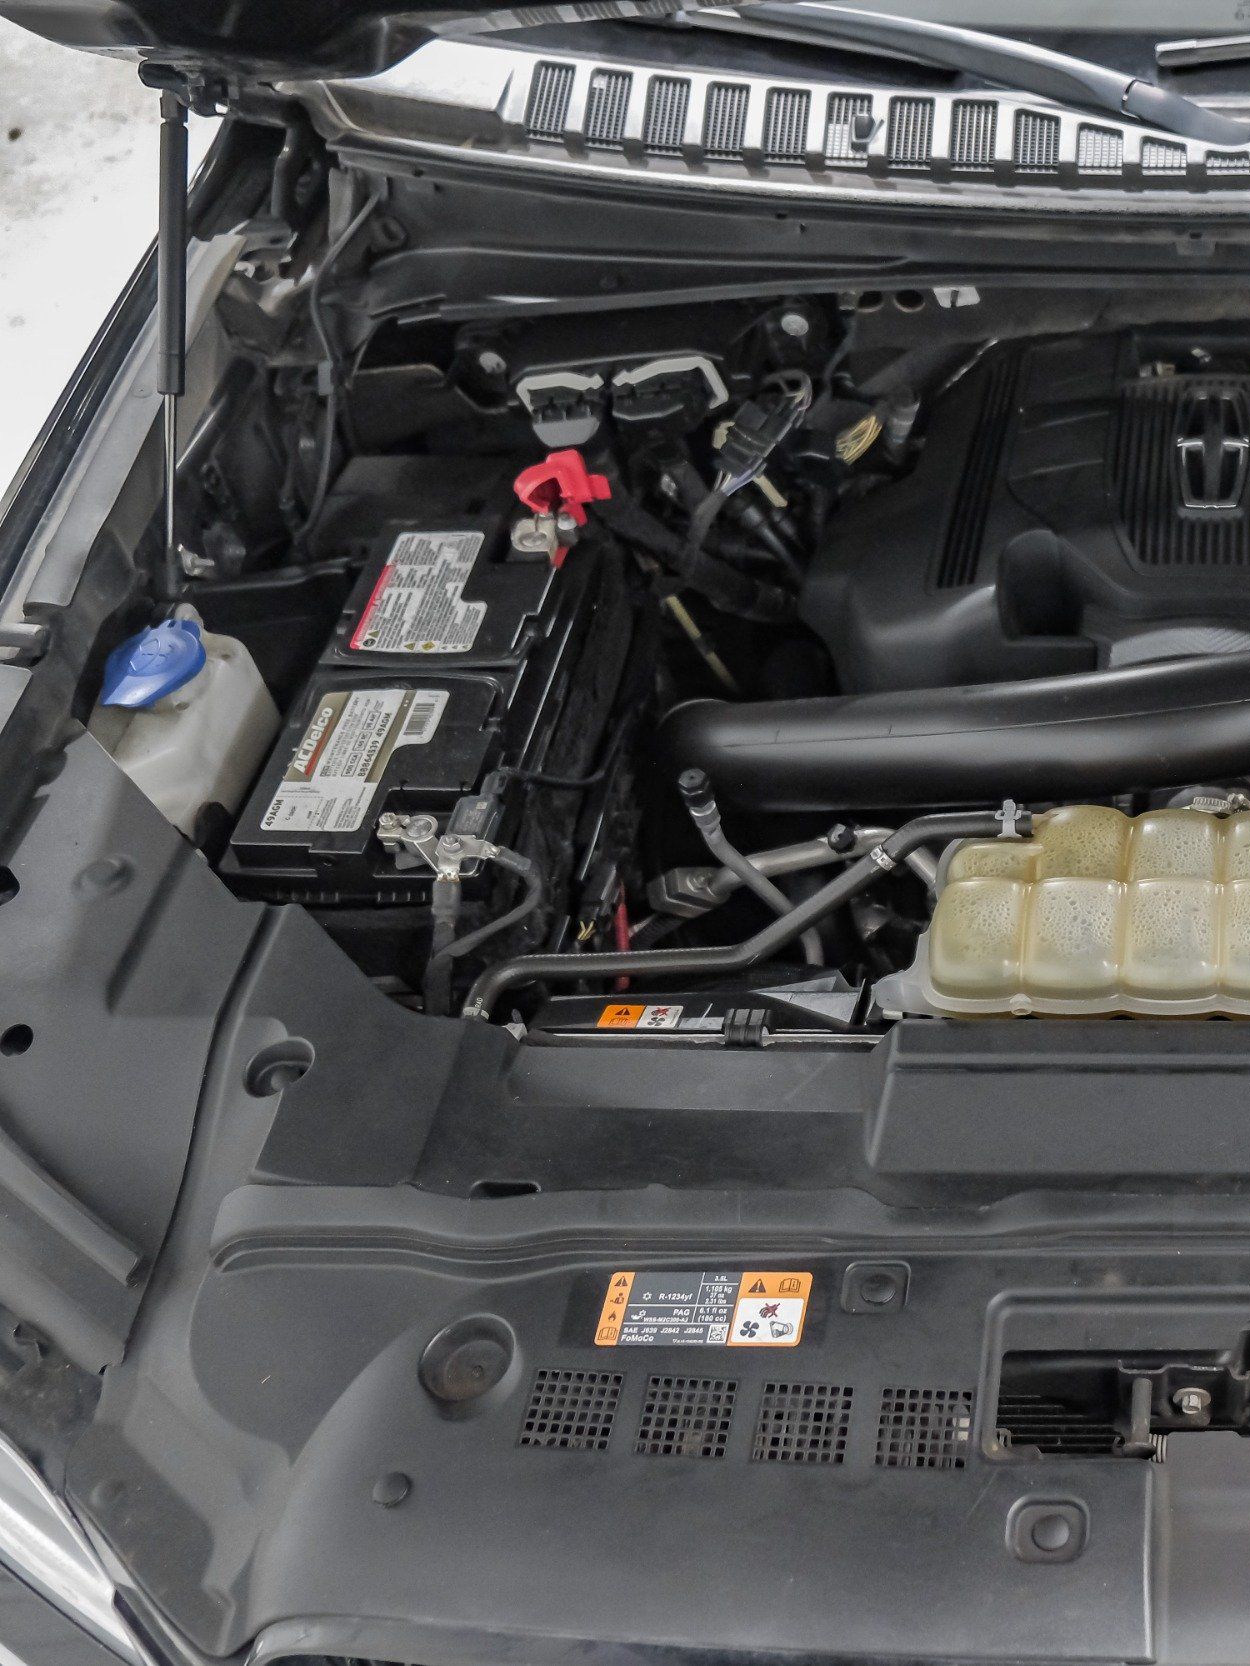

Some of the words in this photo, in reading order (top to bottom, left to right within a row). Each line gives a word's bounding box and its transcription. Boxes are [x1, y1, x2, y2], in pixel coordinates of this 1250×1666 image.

[376, 712, 391, 738] 49AGM
[293, 707, 333, 774] ACDelco
[265, 799, 284, 827] 49AGM
[723, 1285, 733, 1294] kg
[659, 1293, 693, 1302] R-1234yf
[673, 1308, 690, 1316] PAG
[621, 1334, 654, 1342] FoMoCo
